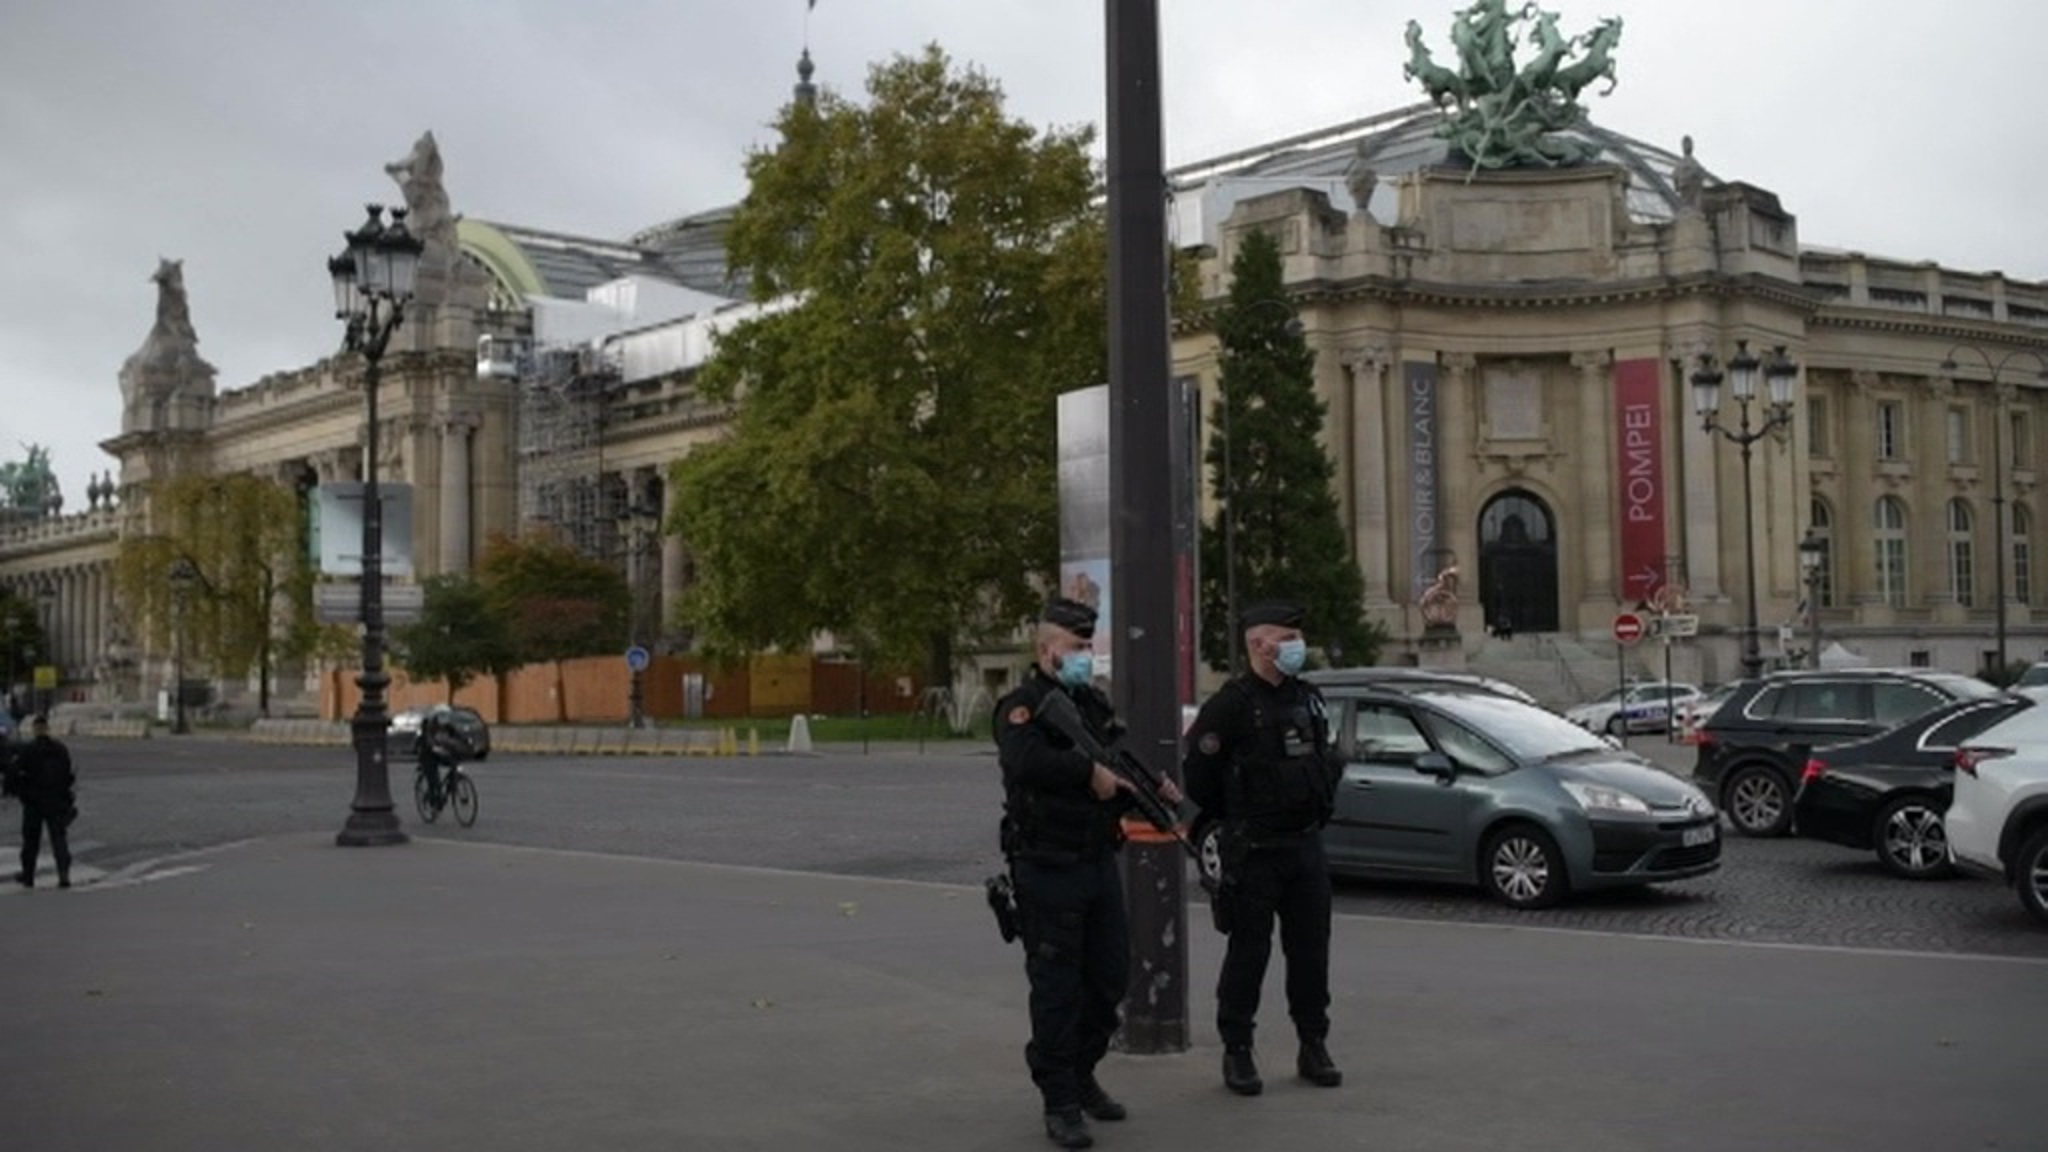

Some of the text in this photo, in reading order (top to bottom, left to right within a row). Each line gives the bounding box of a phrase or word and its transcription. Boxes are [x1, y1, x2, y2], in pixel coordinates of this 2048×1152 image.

[1411, 377, 1435, 556] NOIR & BLANC
[1624, 403, 1655, 522] POMPEI
